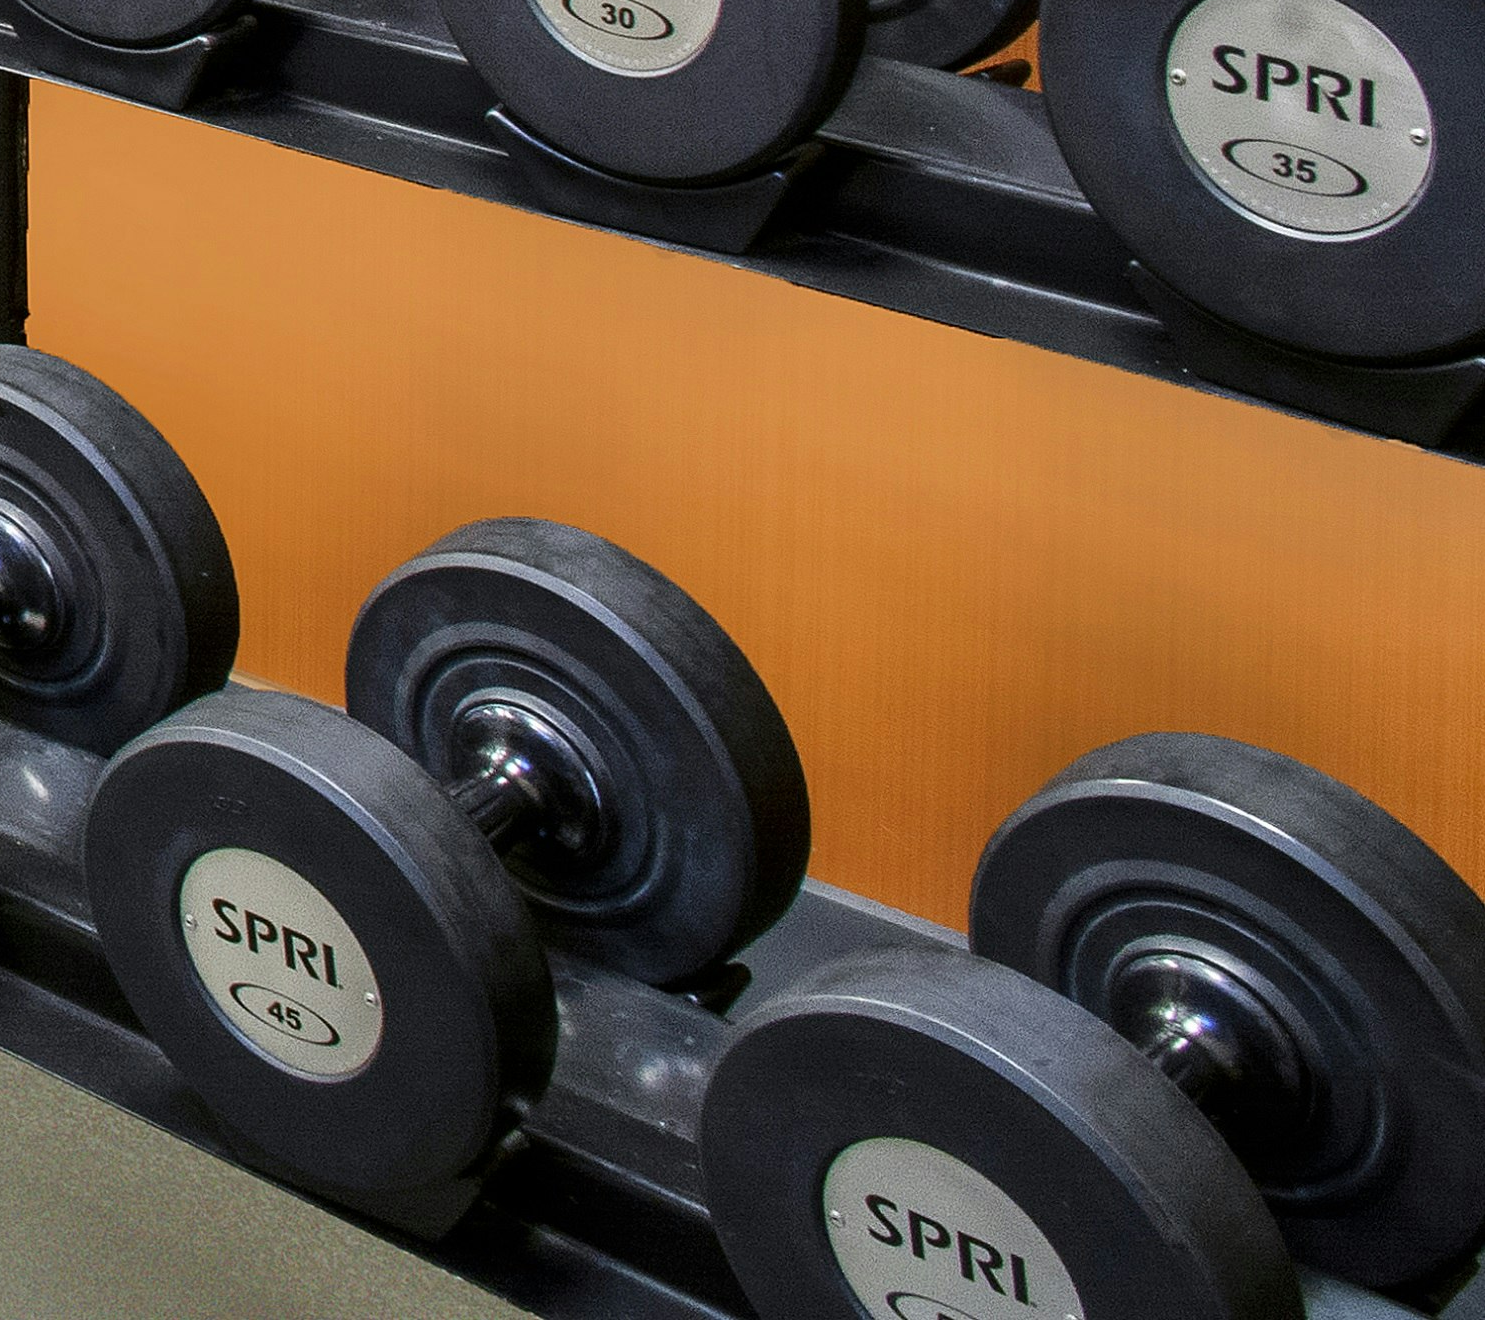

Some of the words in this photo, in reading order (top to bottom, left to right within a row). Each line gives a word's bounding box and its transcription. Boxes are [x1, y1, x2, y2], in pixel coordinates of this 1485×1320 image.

[601, 3, 635, 29] 30
[1212, 45, 1374, 127] SPRI
[1272, 153, 1317, 183] 35
[212, 898, 338, 988] SPRI
[267, 1002, 302, 1031] 45
[865, 1194, 1029, 1306] SPRI
